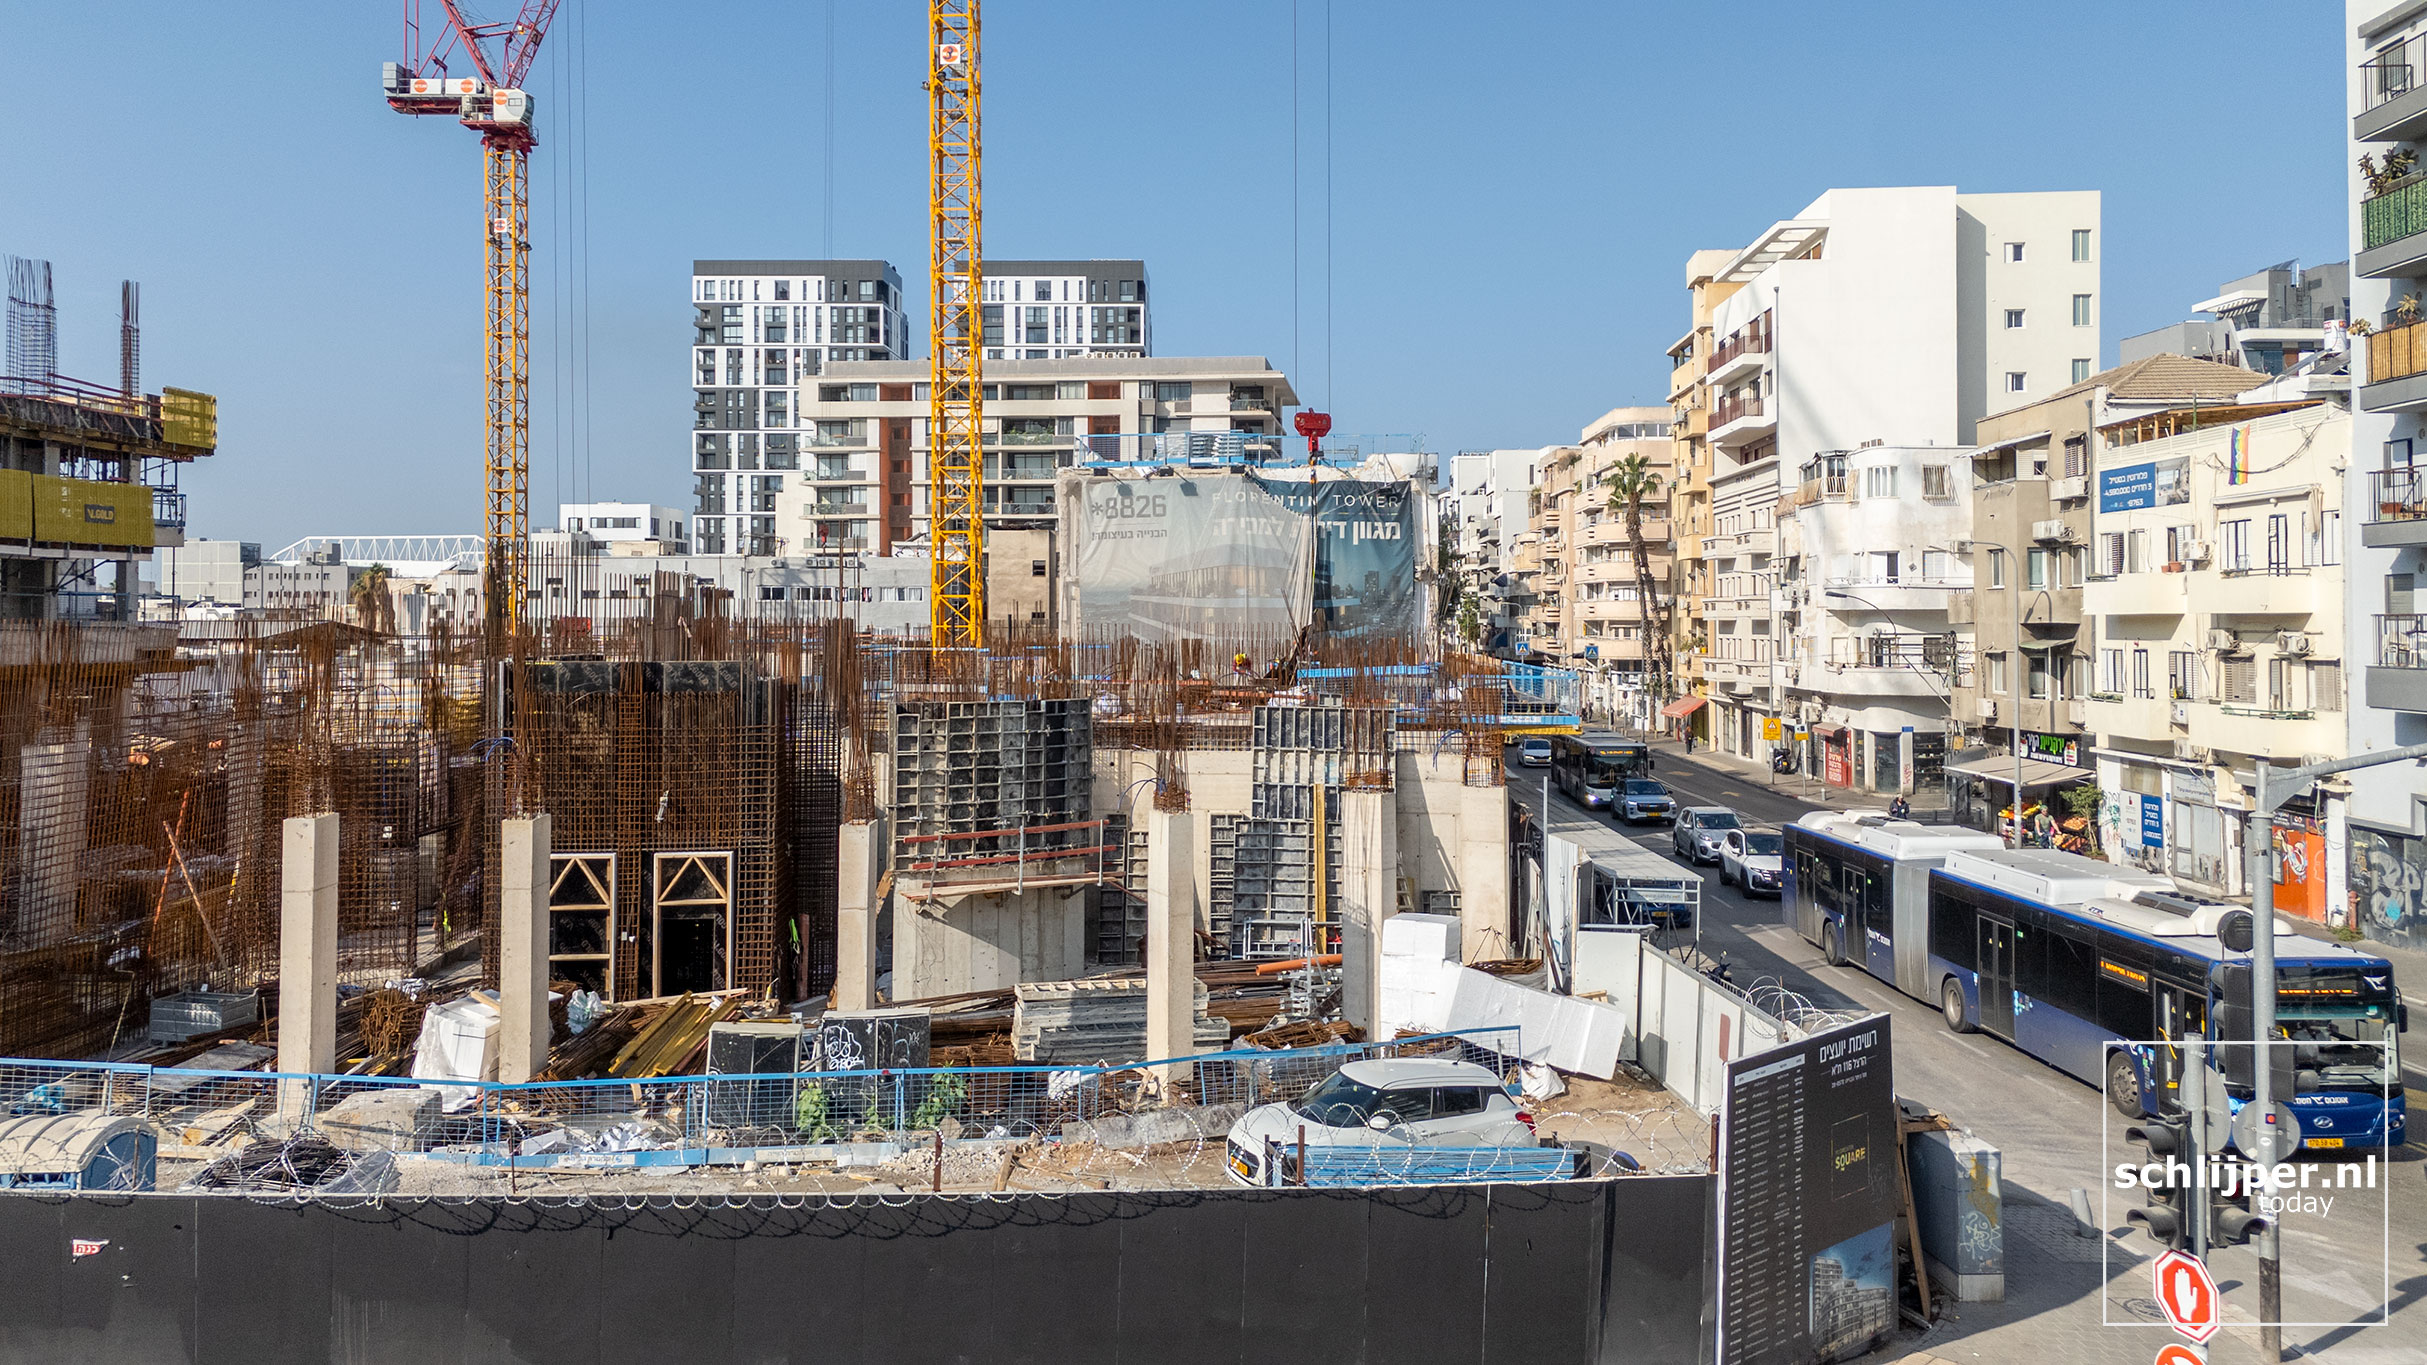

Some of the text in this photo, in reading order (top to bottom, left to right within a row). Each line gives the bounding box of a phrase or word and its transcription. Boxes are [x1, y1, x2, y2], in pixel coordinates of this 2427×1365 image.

[943, 46, 954, 60] 3
[1212, 493, 1400, 509] FLORENTIN TOWER
[1136, 528, 1168, 539] הבנייה
[1352, 520, 1401, 546] מגוון
[1819, 1030, 1878, 1064] רשימת יועצים
[1852, 1055, 1867, 1071] הרצל
[1835, 1147, 1866, 1171] SQUARE
